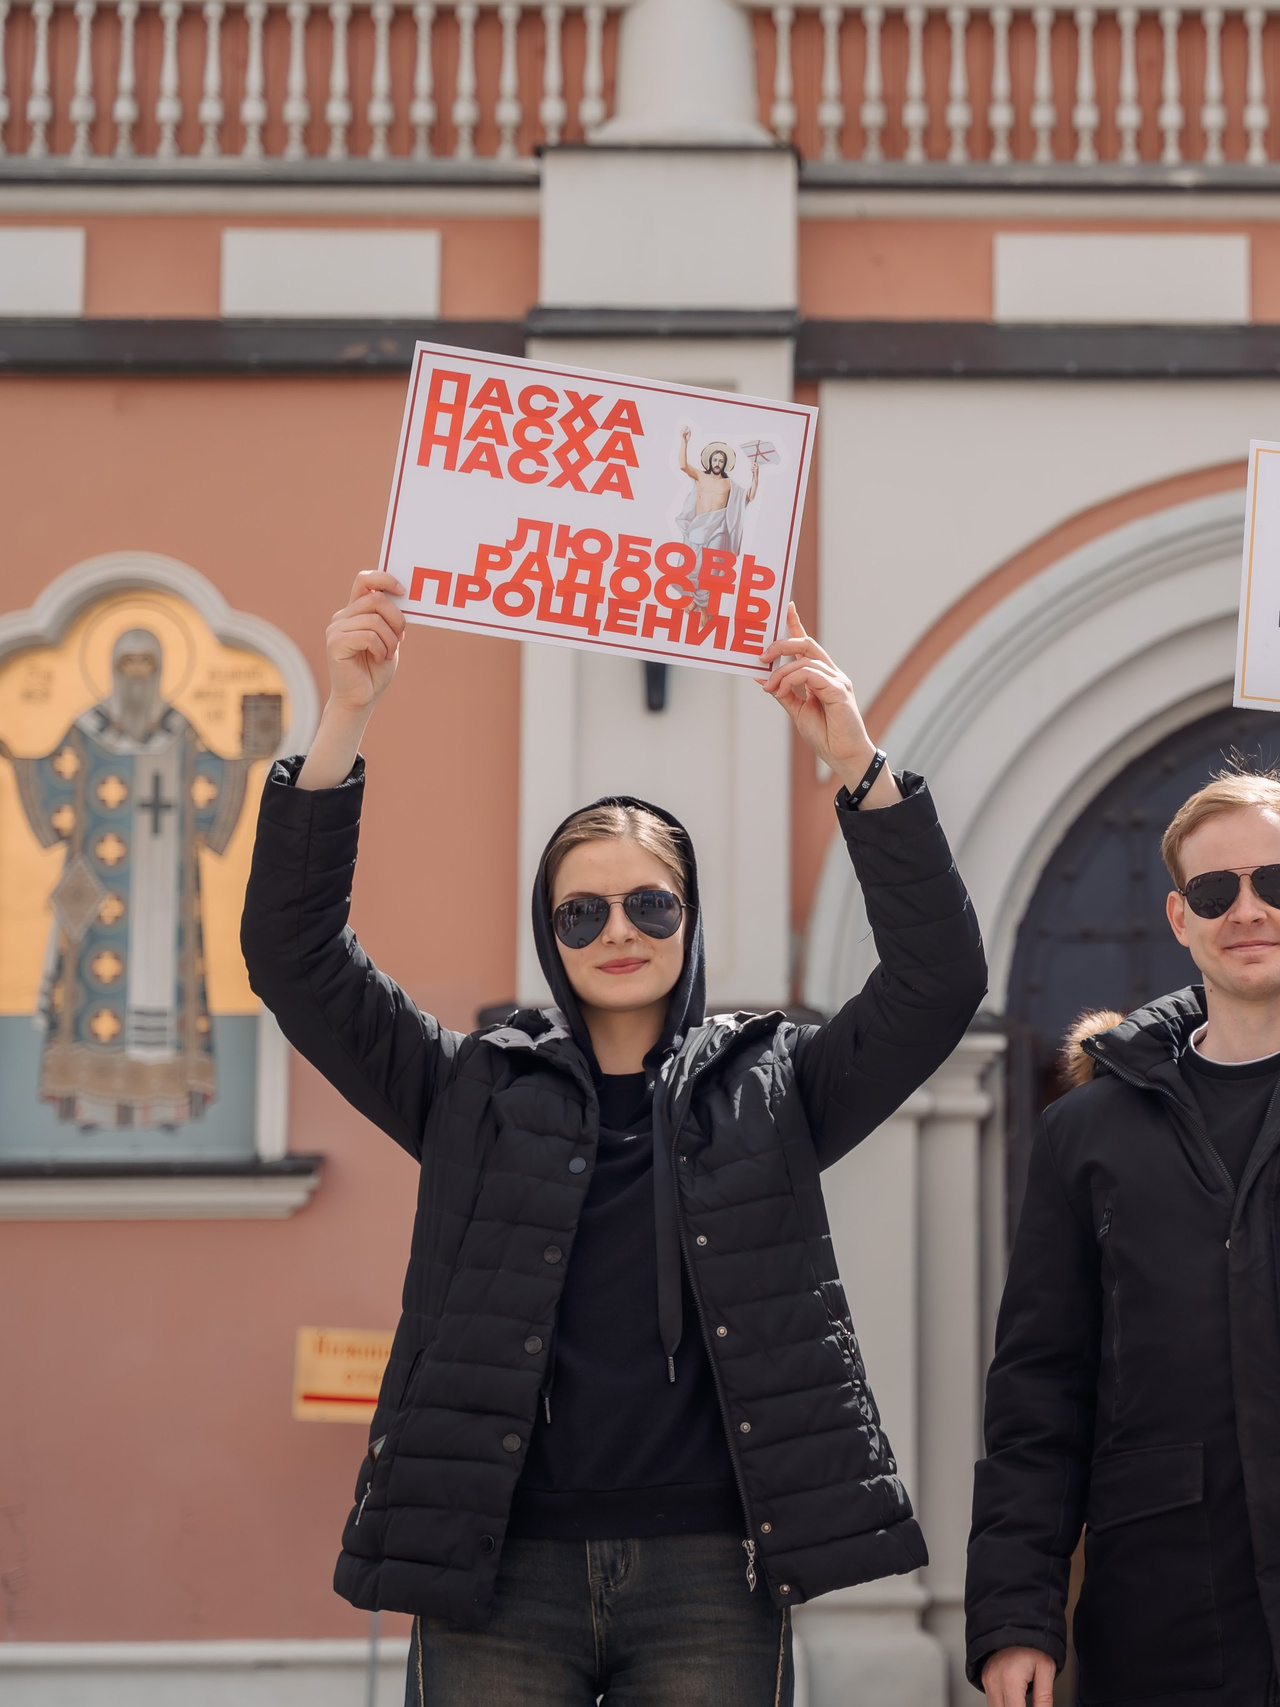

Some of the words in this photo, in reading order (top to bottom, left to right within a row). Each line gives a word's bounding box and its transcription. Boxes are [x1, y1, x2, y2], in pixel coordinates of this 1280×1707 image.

[427, 368, 645, 436] ПАСХА
[474, 543, 771, 623] РАДОСТЬ
[505, 517, 776, 591] ЛЮБОВЬ
[408, 566, 768, 655] ПРОЩЕНИЕ
